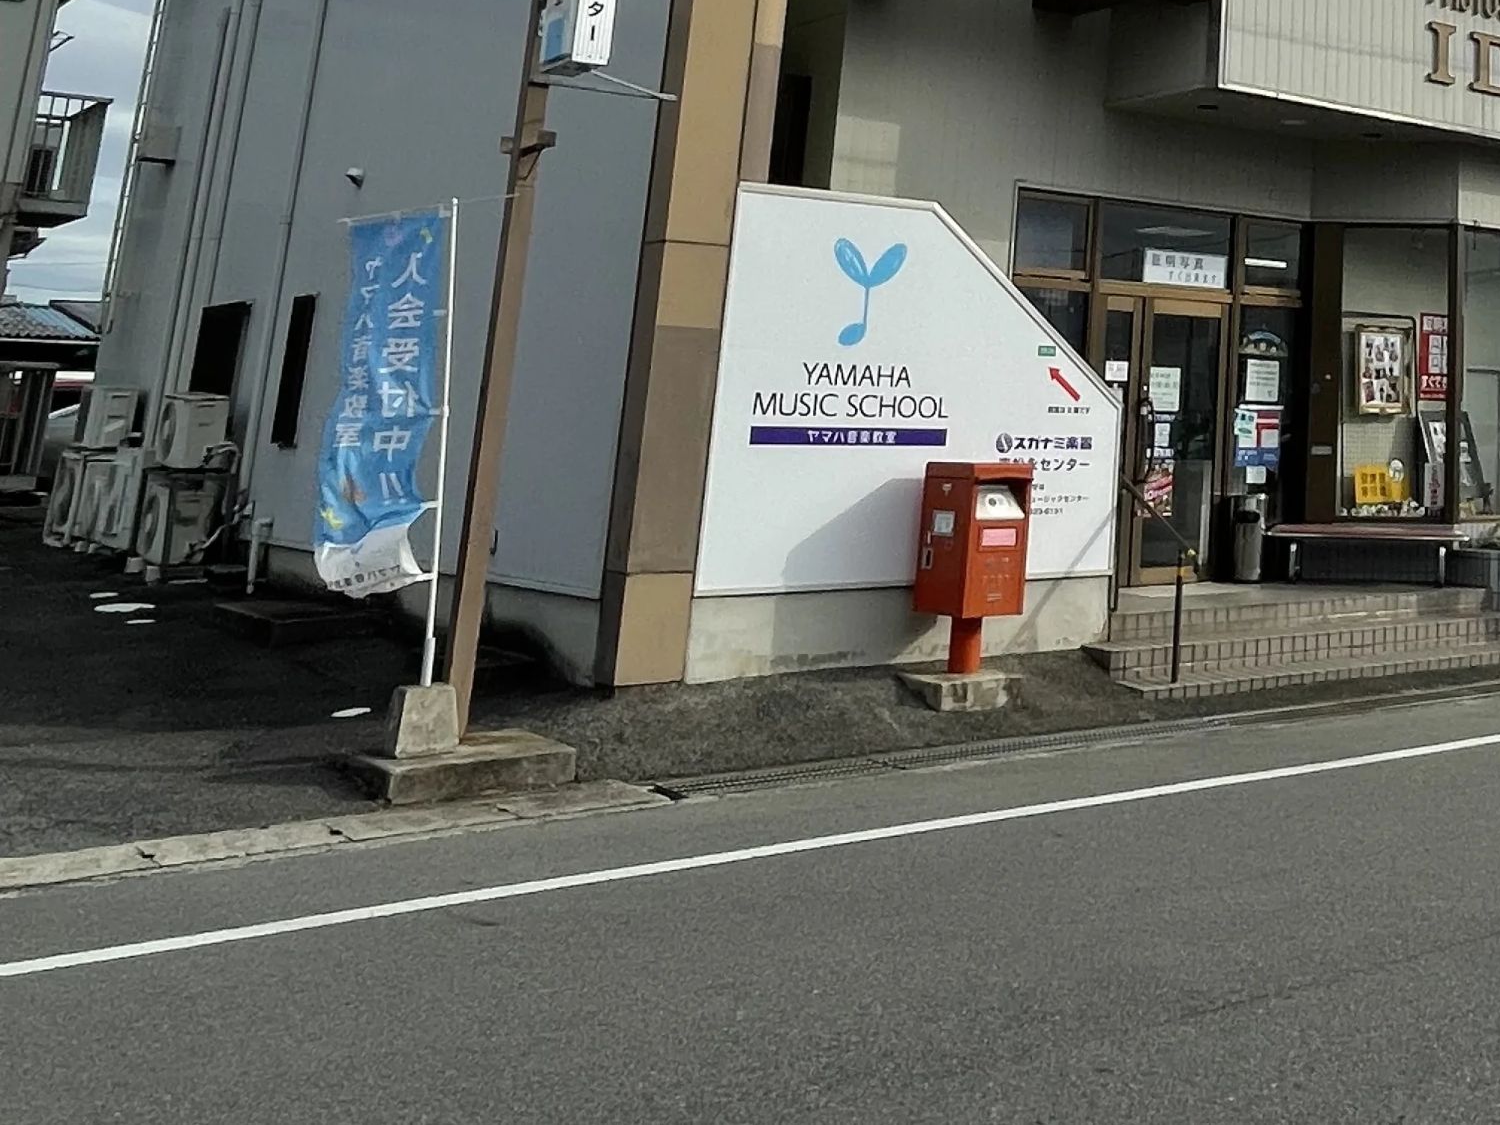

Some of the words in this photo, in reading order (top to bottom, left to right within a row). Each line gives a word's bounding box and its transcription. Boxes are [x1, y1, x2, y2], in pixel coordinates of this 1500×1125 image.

[803, 361, 912, 389] YAMAHA
[752, 391, 838, 419] MUSIC
[845, 393, 949, 420] SCHOOL
[806, 428, 898, 446] ヤマハ音楽教室
[1013, 436, 1093, 451] スガナミ楽器
